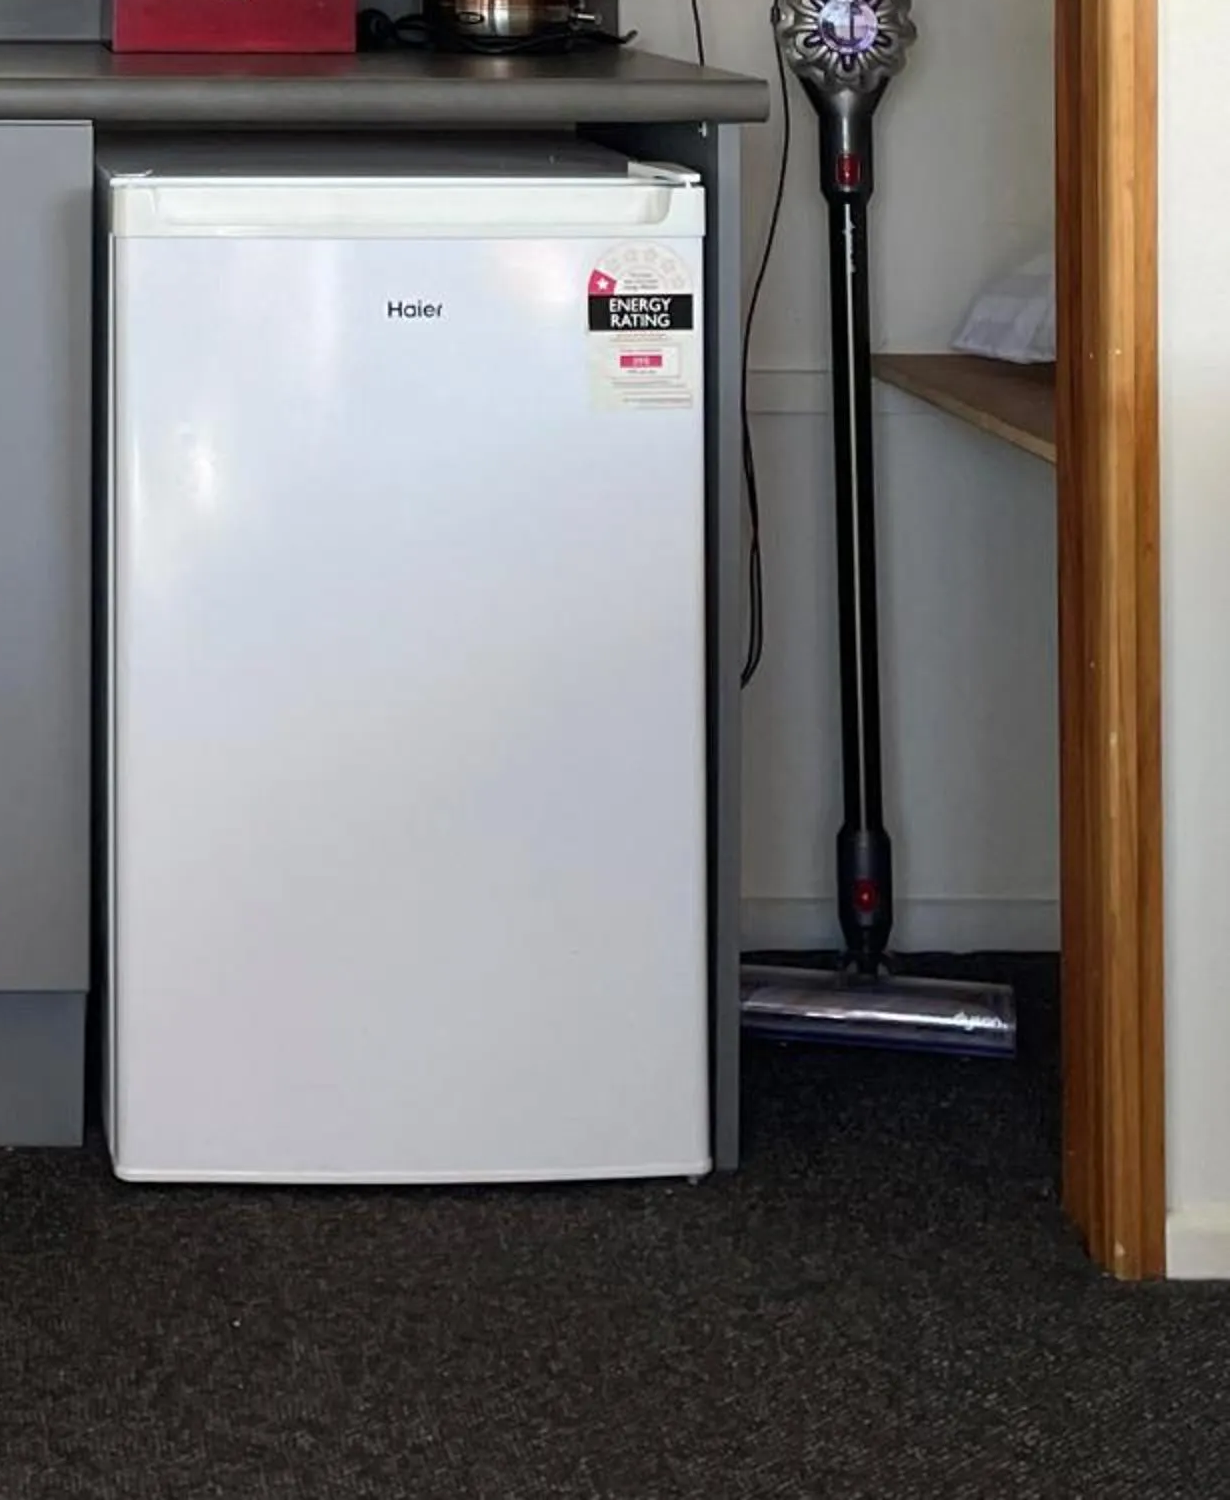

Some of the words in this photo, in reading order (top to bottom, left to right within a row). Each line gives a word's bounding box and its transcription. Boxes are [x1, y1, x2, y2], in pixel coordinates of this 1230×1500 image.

[387, 299, 443, 318] Haier
[608, 297, 672, 313] ENERGY
[609, 313, 671, 328] RATING
